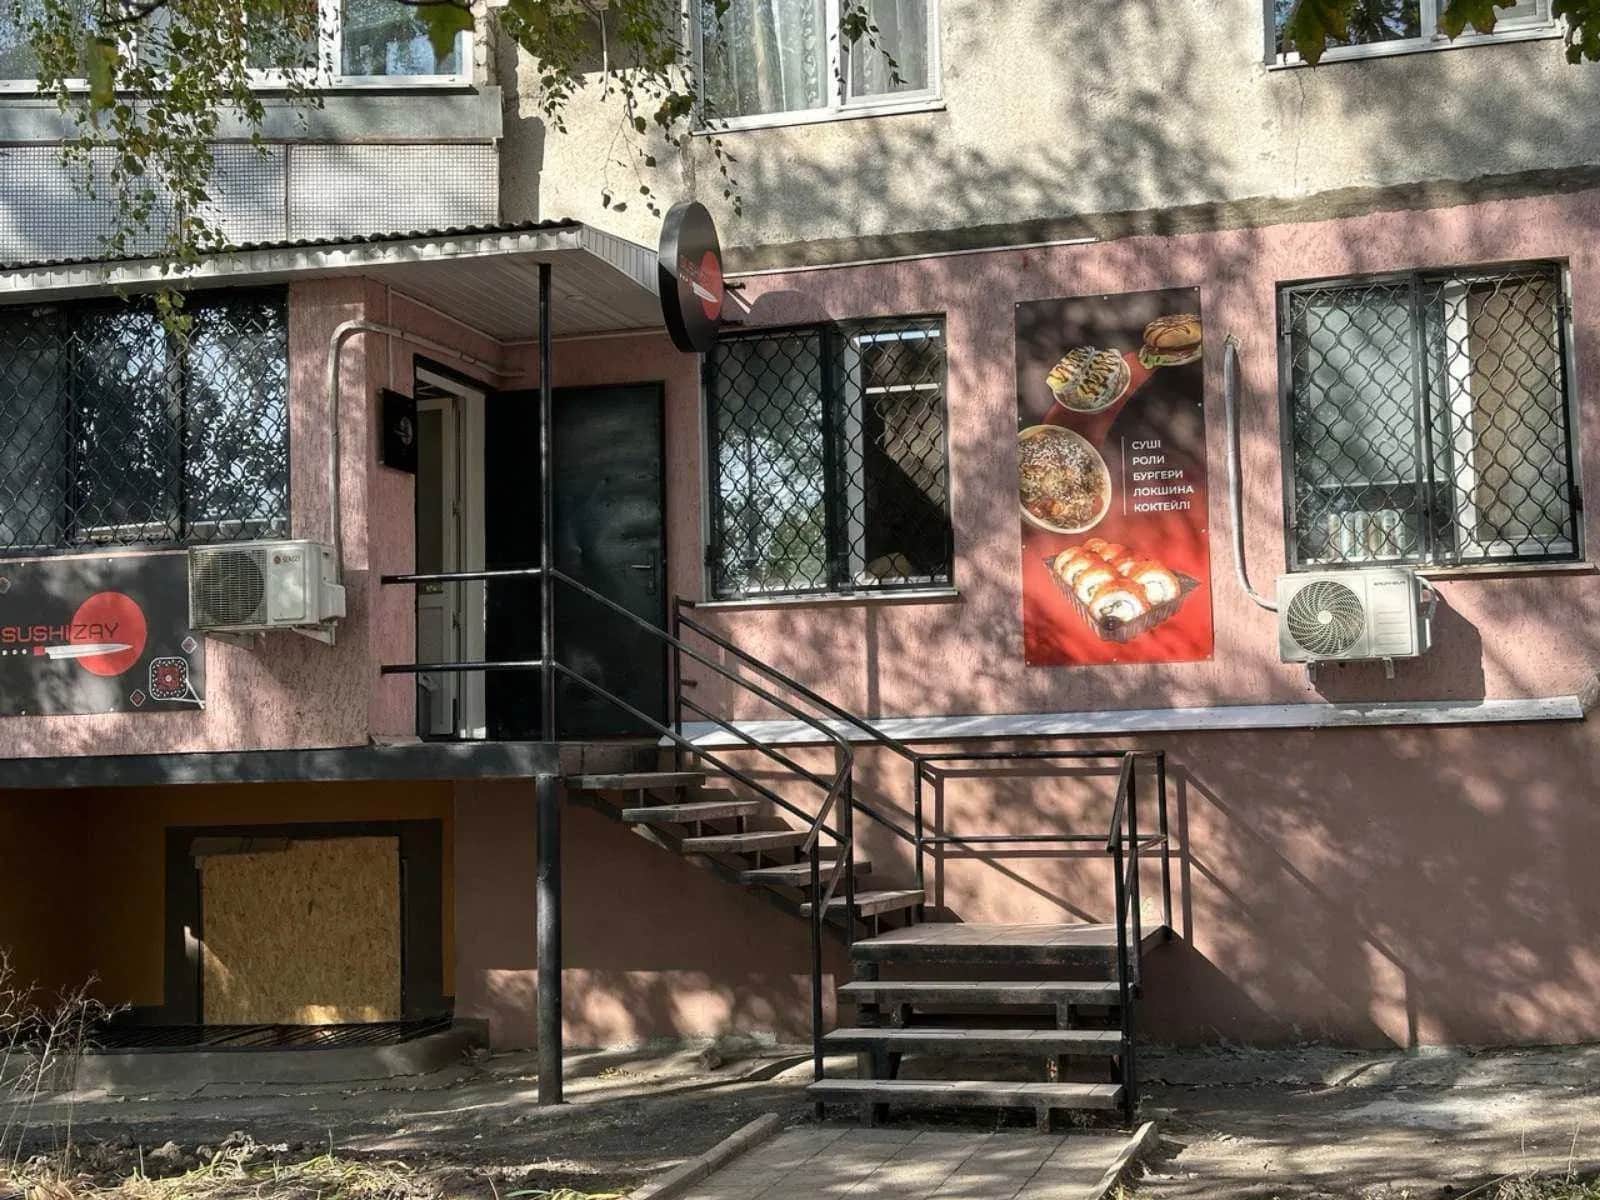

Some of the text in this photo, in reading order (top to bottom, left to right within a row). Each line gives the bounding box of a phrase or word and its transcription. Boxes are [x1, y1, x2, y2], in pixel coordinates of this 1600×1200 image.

[1131, 439, 1161, 450] СУШІ
[1132, 455, 1165, 466] РОЛИ
[1133, 469, 1184, 481] БУРГЕРИ
[1133, 485, 1195, 497] ЛОКШИНА
[1134, 500, 1191, 513] КОКТЕЙЛІ
[1, 622, 119, 643] SUSHIZAY
